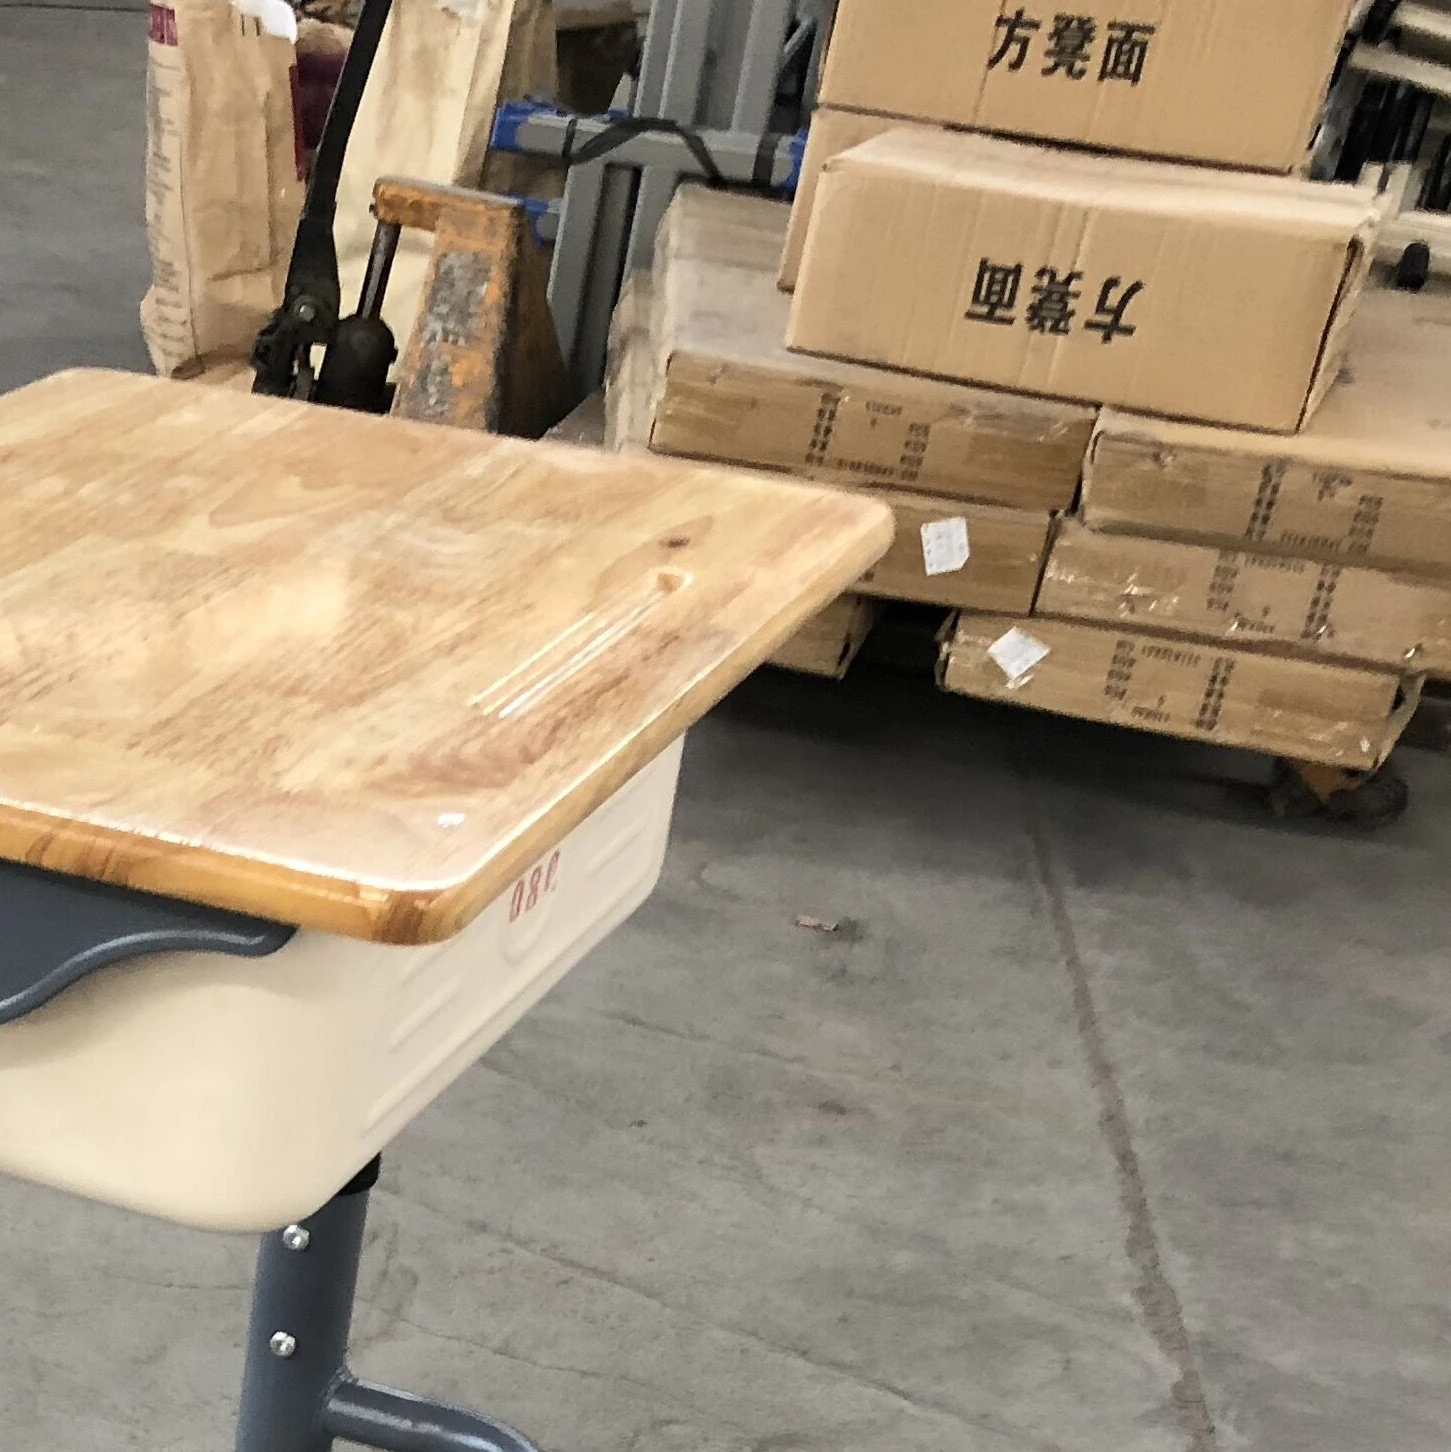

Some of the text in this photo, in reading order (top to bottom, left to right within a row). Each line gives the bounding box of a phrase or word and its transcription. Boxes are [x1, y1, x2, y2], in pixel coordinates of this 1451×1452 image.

[986, 7, 1156, 87] 方凳面
[964, 257, 1145, 344] 方凳面
